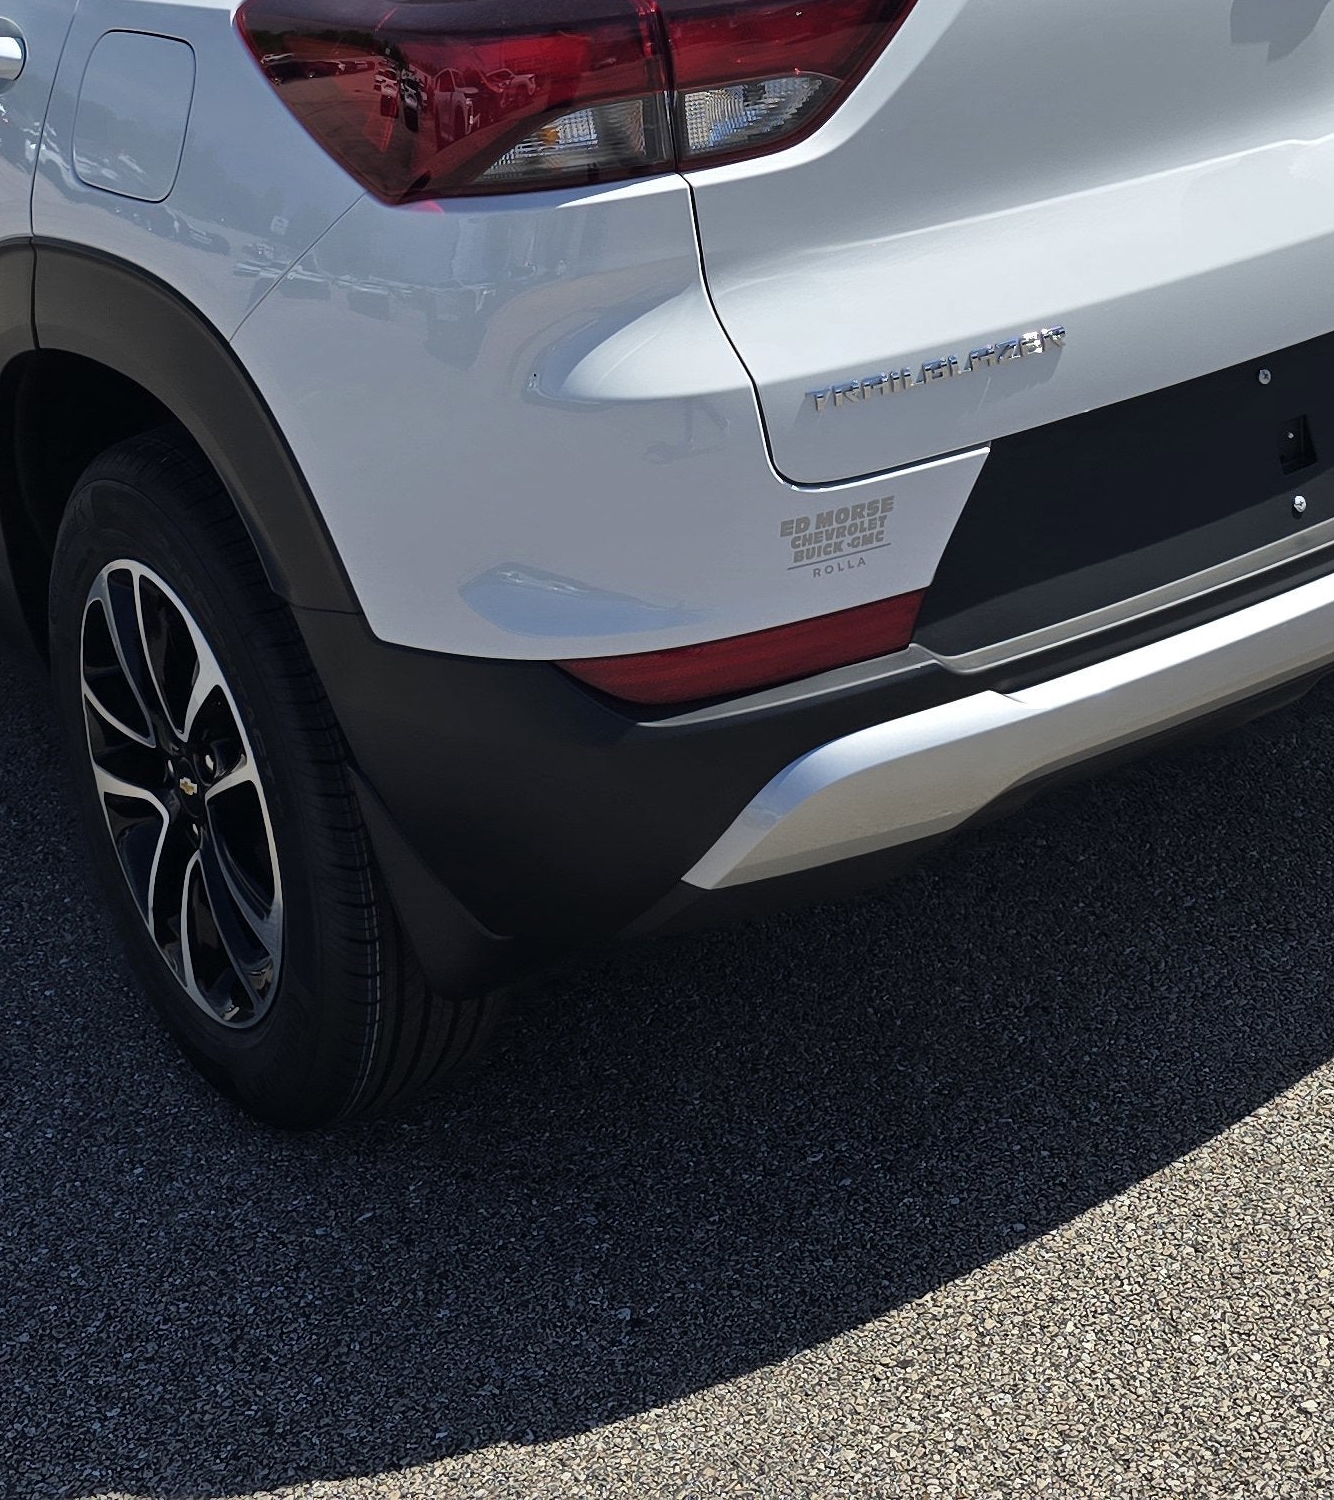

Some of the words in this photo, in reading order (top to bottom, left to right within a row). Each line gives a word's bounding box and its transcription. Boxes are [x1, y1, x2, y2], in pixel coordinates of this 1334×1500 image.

[805, 324, 1066, 411] TRAILBLAZER
[779, 515, 810, 538] ED
[815, 495, 895, 531] MORSE
[790, 514, 889, 549] CHEVROLET
[793, 540, 844, 563] BUICK
[813, 556, 867, 578] ROLLA
